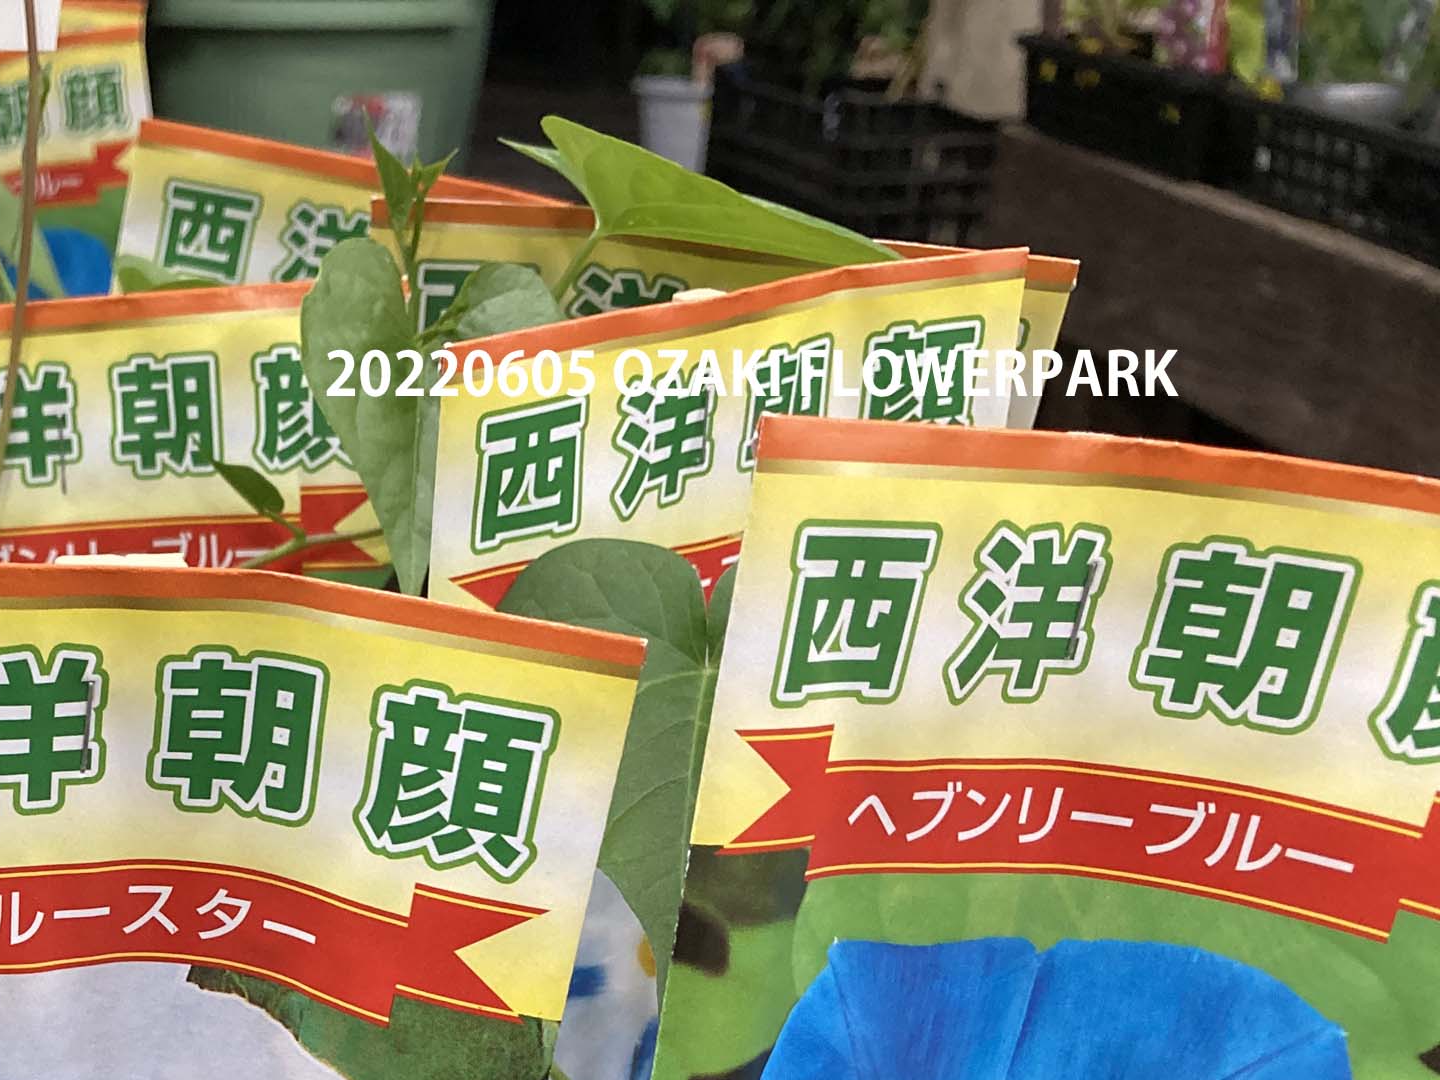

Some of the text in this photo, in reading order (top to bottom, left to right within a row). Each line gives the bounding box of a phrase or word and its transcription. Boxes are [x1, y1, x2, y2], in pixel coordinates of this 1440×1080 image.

[847, 780, 1355, 875] ヘブンリーブルー
